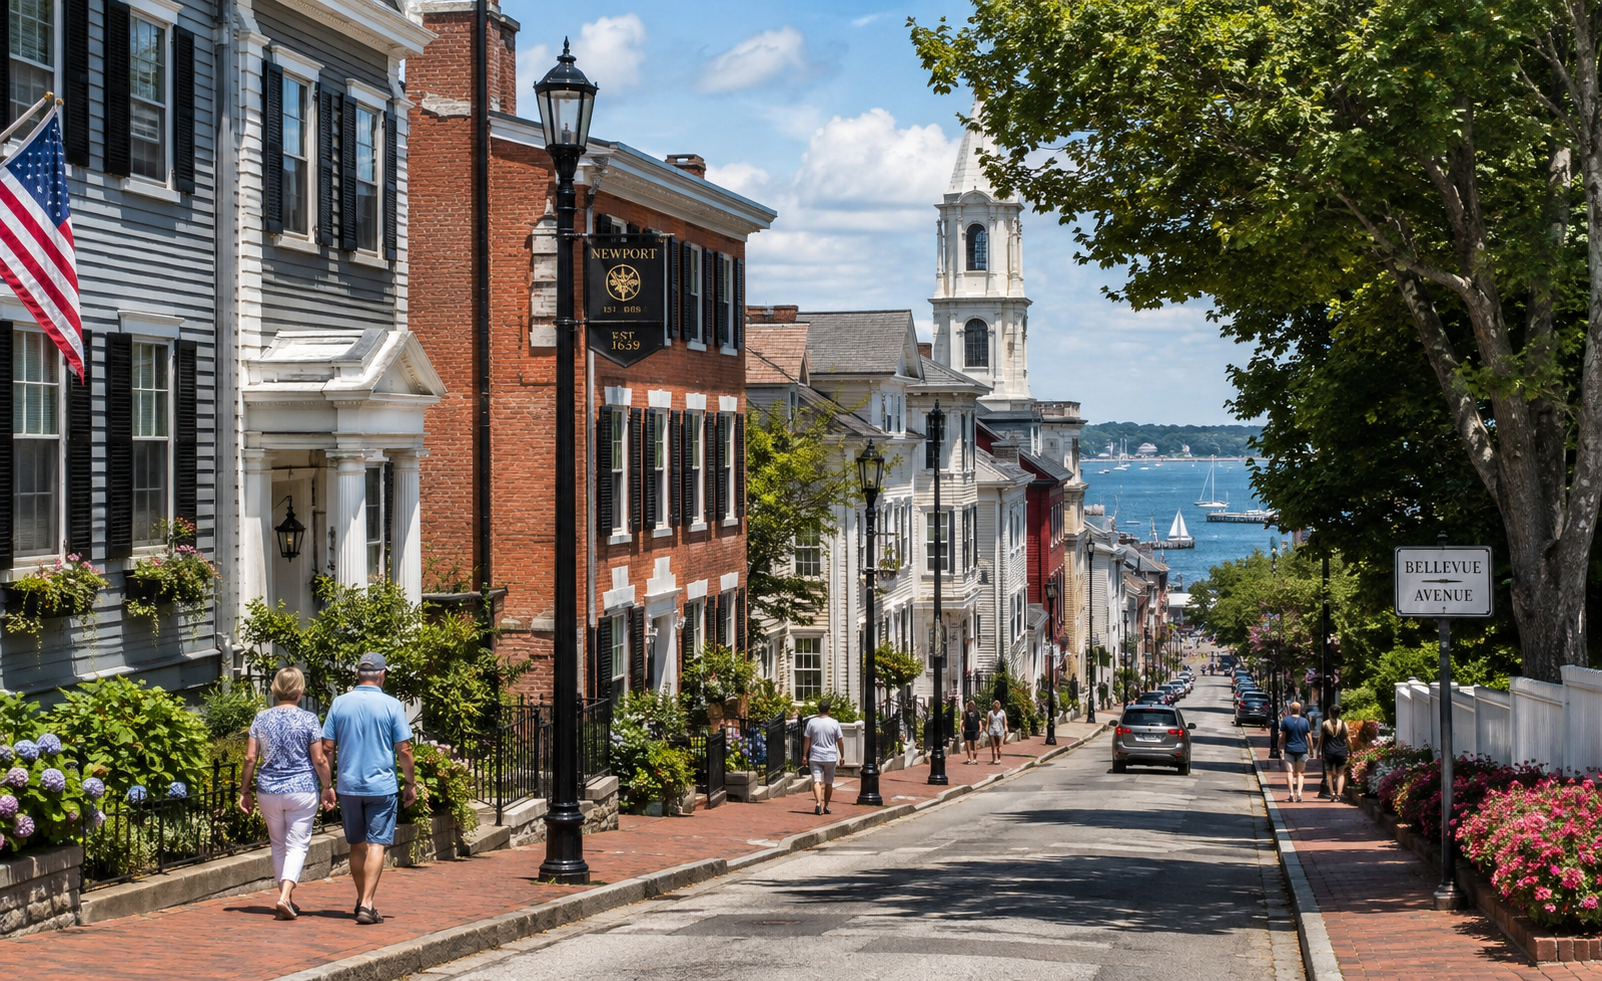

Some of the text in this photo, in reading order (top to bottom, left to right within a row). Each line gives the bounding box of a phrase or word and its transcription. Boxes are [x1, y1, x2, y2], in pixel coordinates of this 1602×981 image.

[591, 248, 657, 259] NEWPORT
[612, 331, 634, 340] EST
[1405, 561, 1481, 574] BELLEVUE
[1415, 589, 1473, 601] AVENUE
